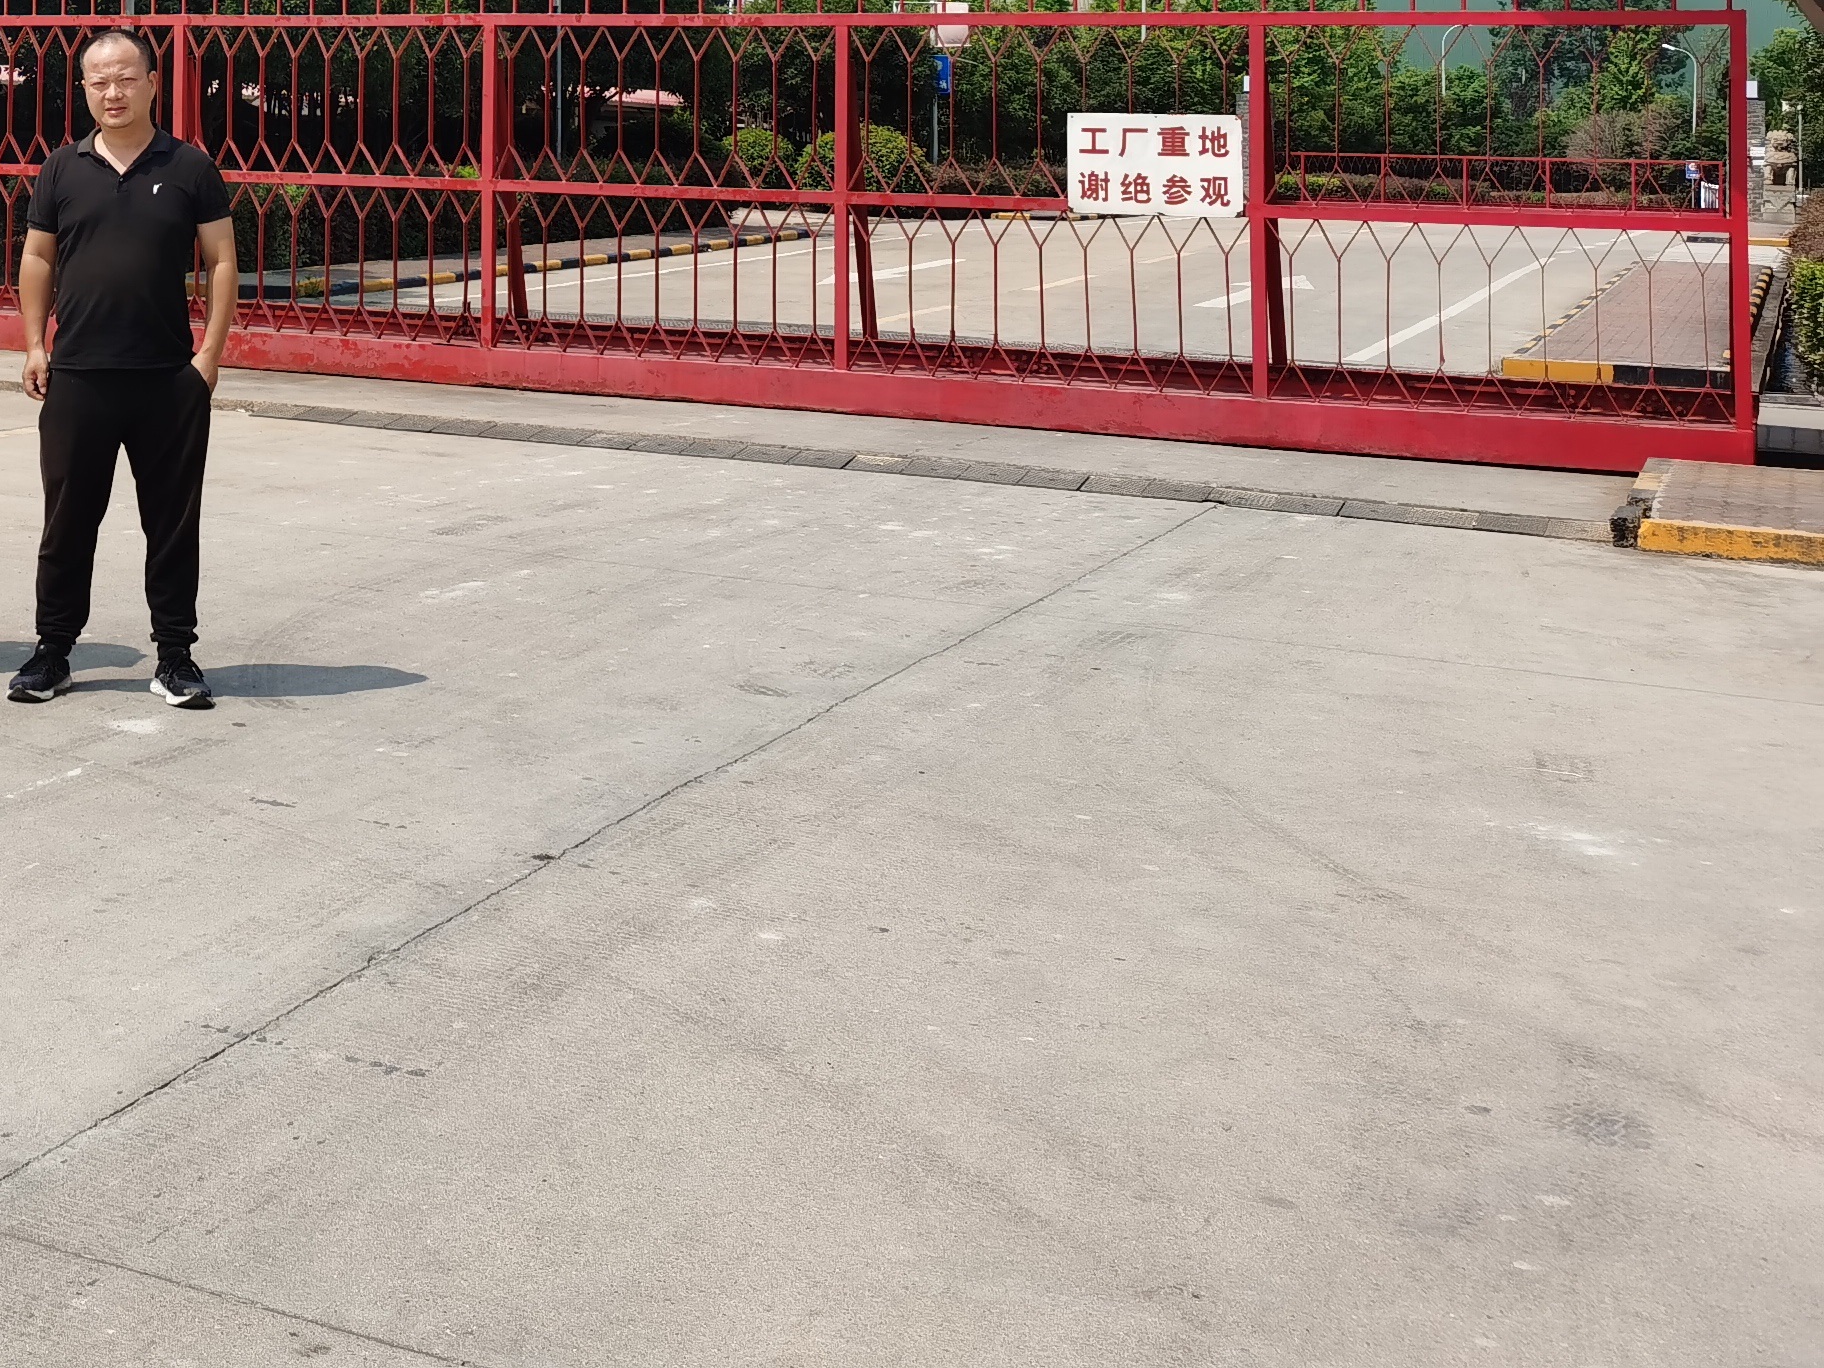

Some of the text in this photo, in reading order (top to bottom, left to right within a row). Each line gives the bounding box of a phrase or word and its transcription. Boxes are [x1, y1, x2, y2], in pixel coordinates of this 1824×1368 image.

[1078, 125, 1230, 158] 工厂重地
[1077, 170, 1232, 207] 谢绝参观
